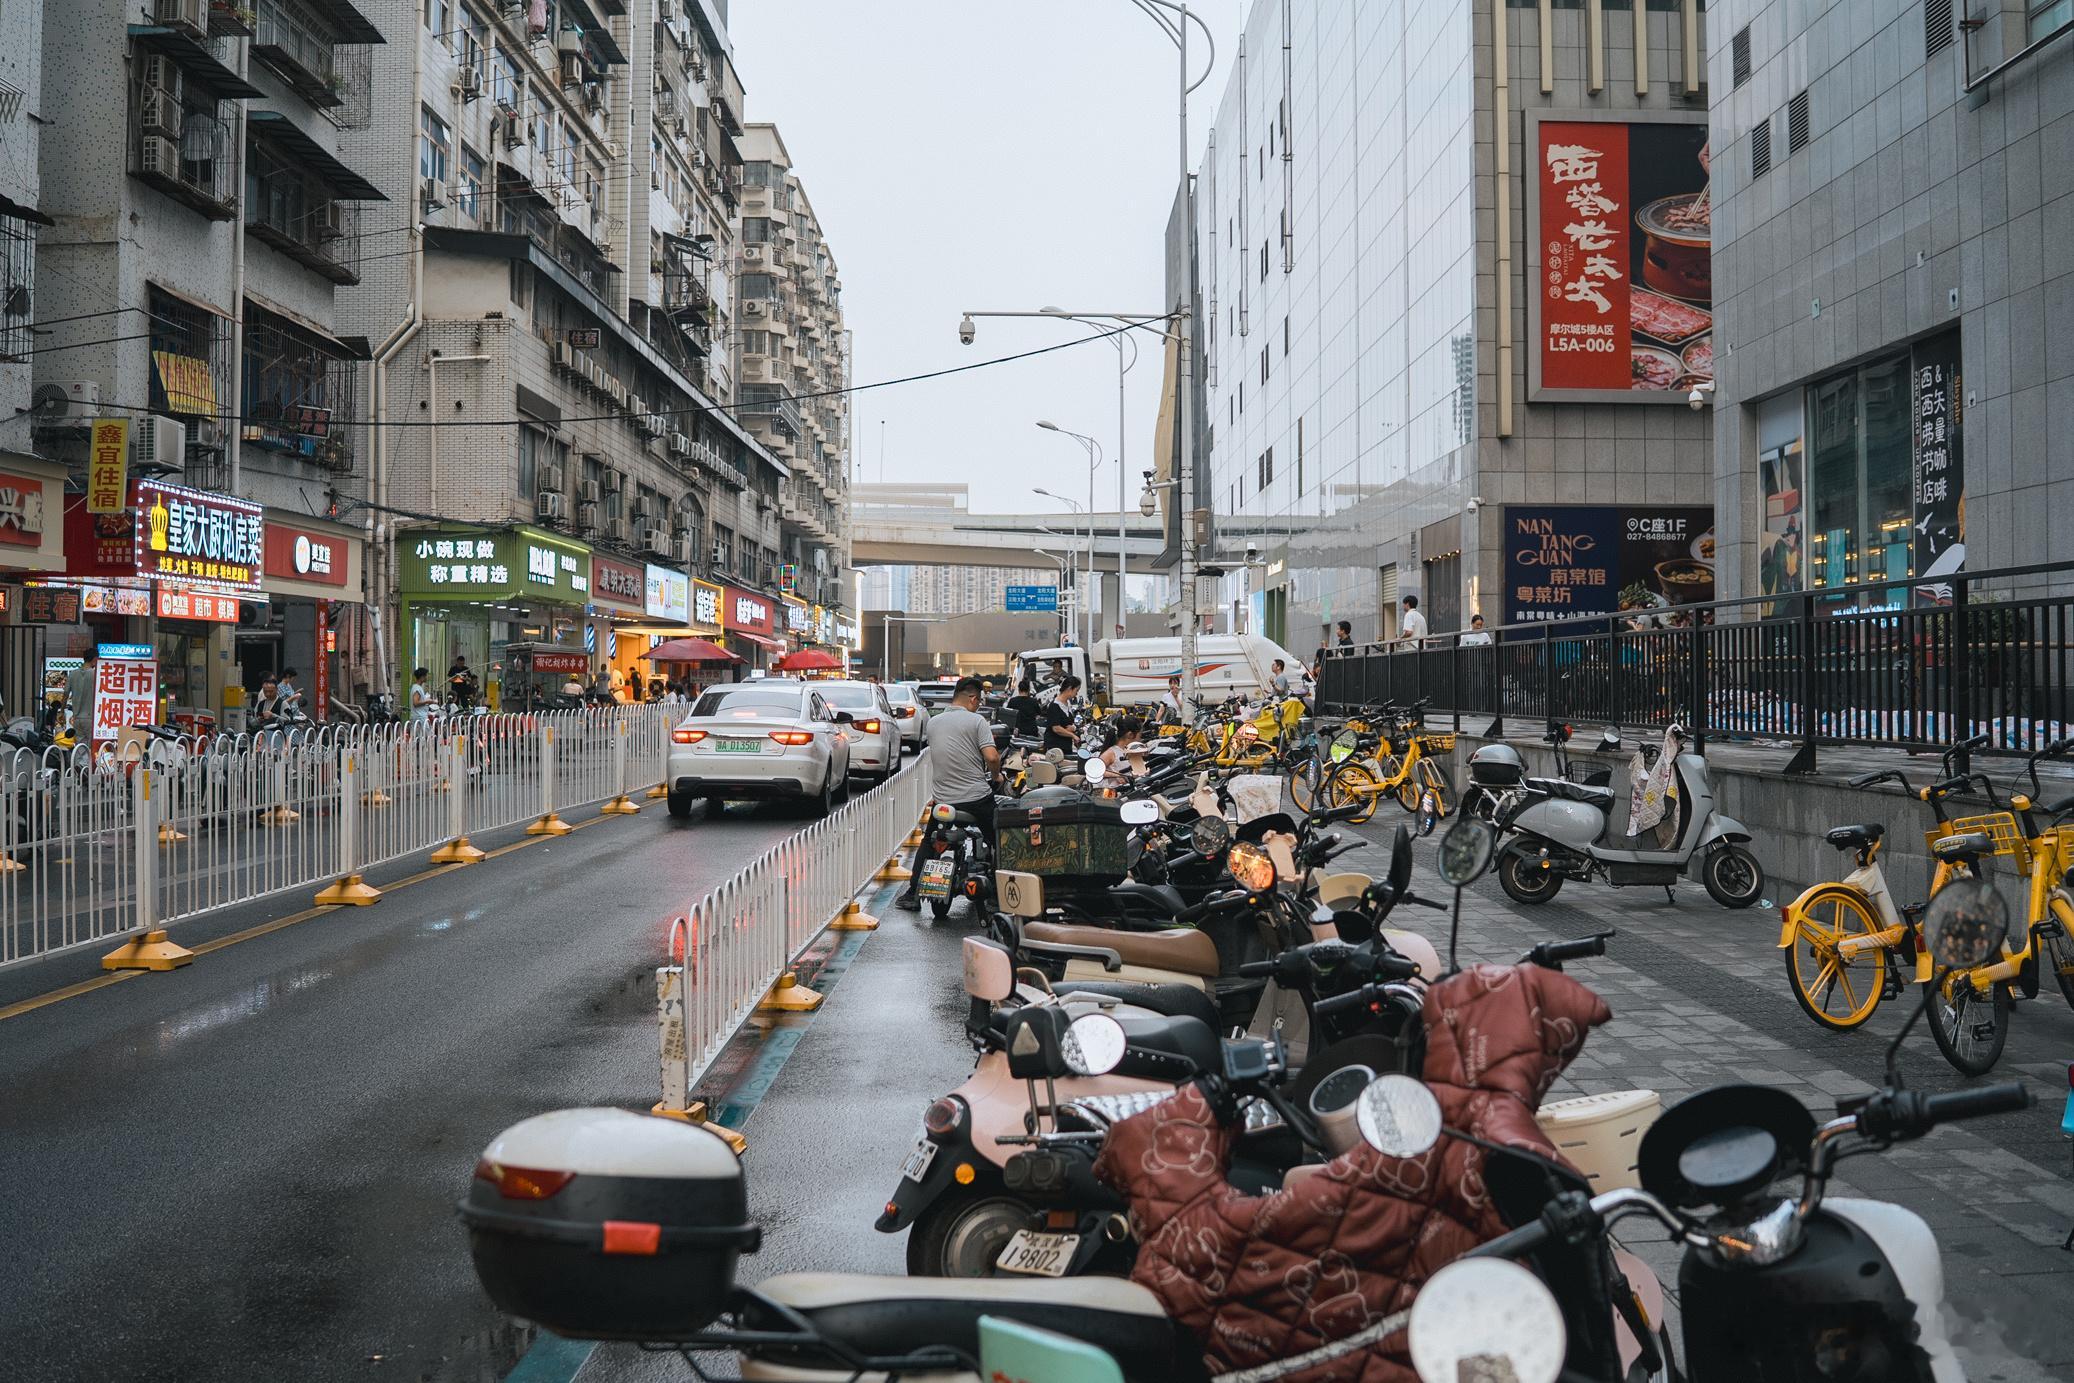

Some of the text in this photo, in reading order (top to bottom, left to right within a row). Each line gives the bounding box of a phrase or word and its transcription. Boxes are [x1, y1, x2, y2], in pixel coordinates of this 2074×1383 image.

[1546, 144, 1623, 313] 西塔老太太
[1550, 323, 1615, 336] 摩尔城5楼A区
[1549, 337, 1615, 352] L5A-006
[1920, 365, 1935, 504] 西西弗书店
[93, 424, 122, 508] 鑫宜住宿
[168, 499, 260, 565] 皇家大厨私房菜
[1516, 519, 1552, 534] NAN
[1626, 532, 1687, 541] 027-84868677
[416, 540, 495, 559] 小碗现做
[1540, 534, 1596, 551] TANG
[1516, 550, 1573, 566] GUAN
[1516, 586, 1571, 604] 粤菜坊
[26, 591, 79, 622] 住宿
[195, 597, 212, 617] 超市
[98, 661, 155, 696] 超市
[97, 697, 153, 729] 烟酒
[1004, 1246, 1061, 1272] 19802
